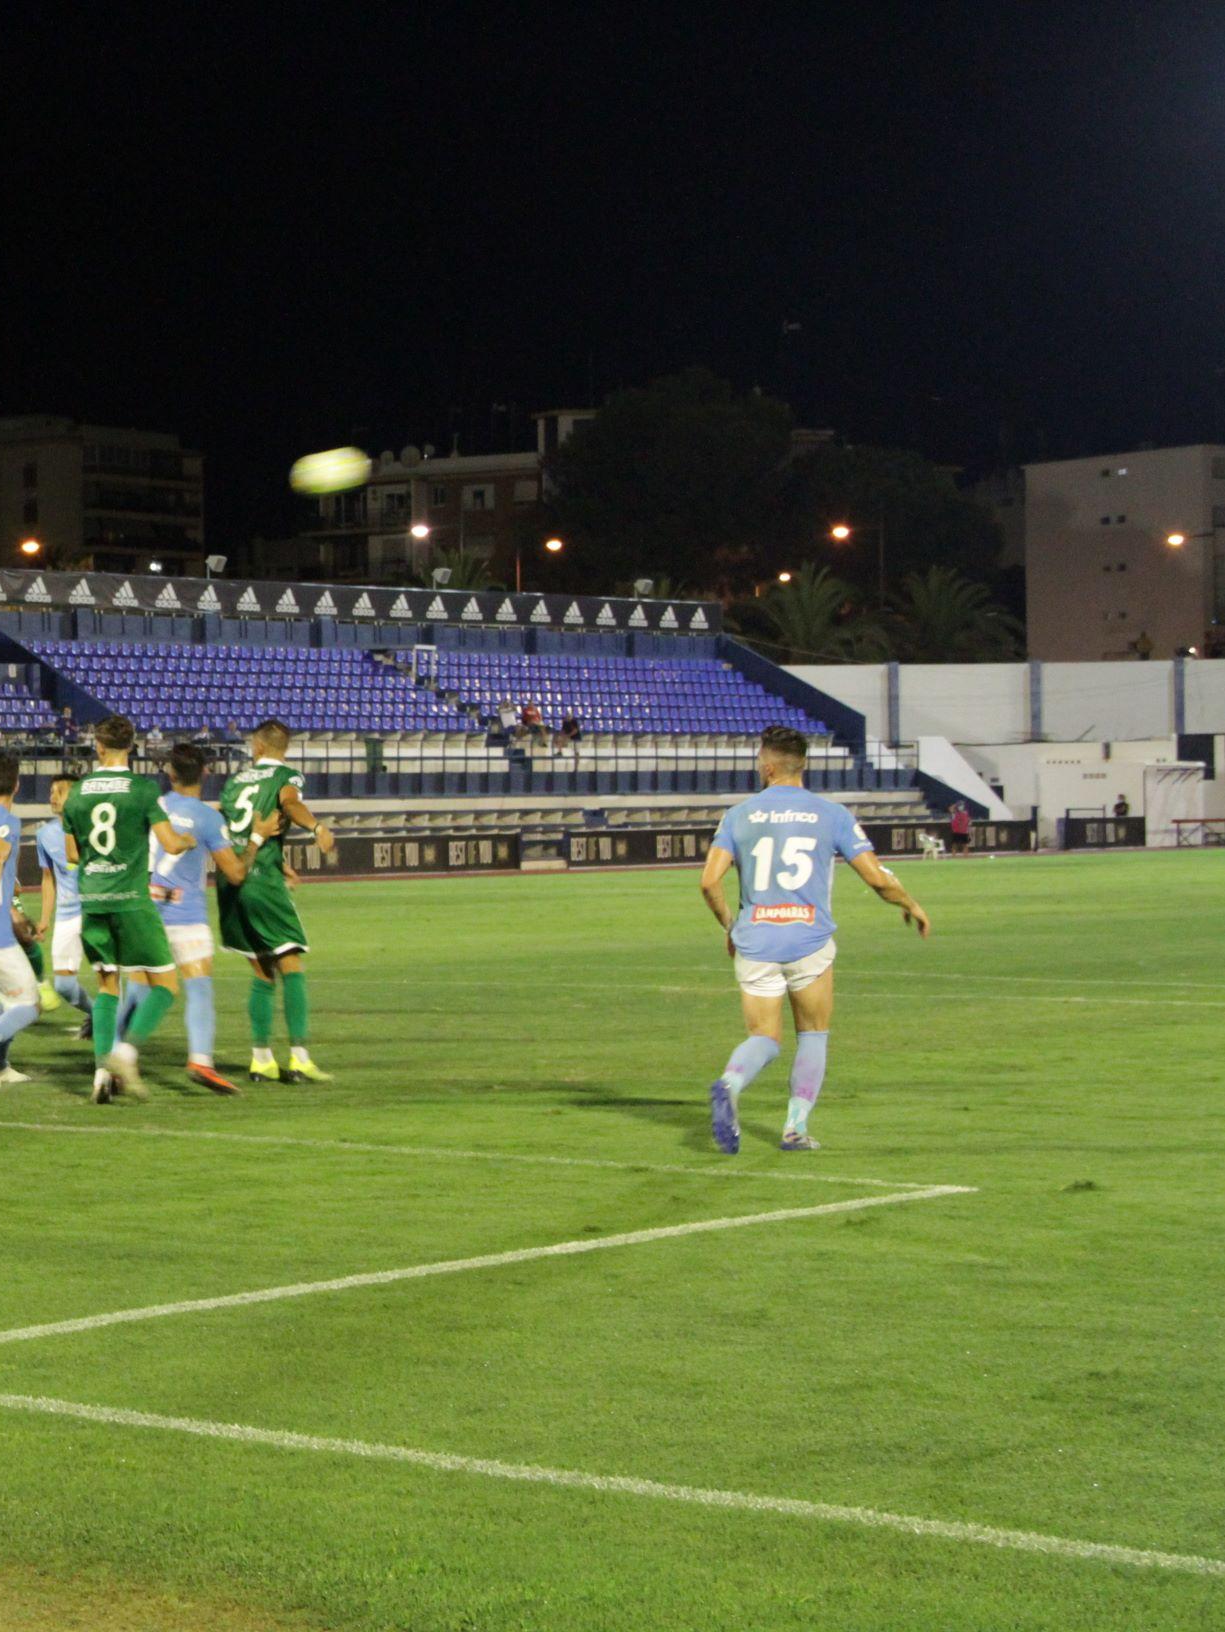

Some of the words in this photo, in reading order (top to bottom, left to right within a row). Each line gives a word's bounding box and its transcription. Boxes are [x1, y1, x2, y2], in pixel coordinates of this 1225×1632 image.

[89, 802, 116, 856] 8
[230, 784, 260, 833] 5
[751, 836, 817, 891] 15
